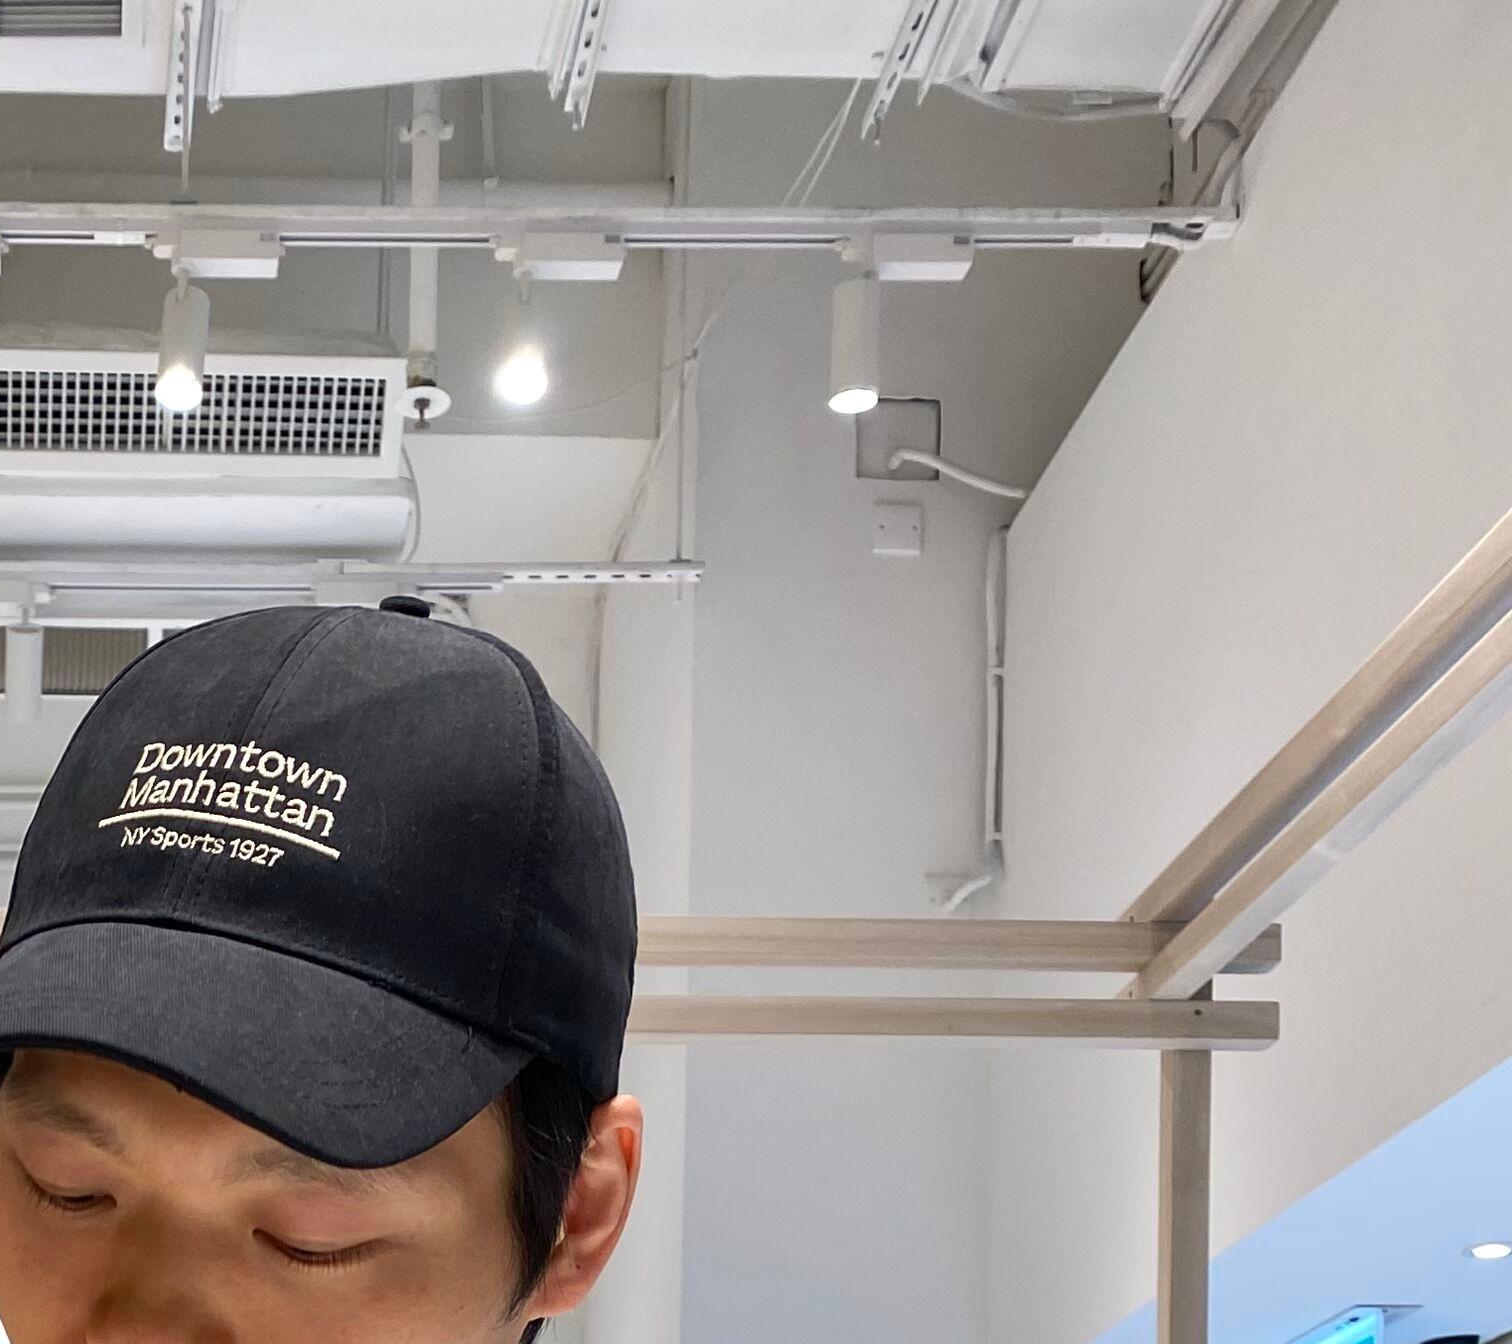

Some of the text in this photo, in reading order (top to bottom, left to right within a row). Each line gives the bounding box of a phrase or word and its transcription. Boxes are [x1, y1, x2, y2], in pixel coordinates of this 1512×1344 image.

[133, 740, 348, 802] Downtown
[119, 771, 336, 837] Manhattan
[121, 826, 284, 868] NY Sports 1927
